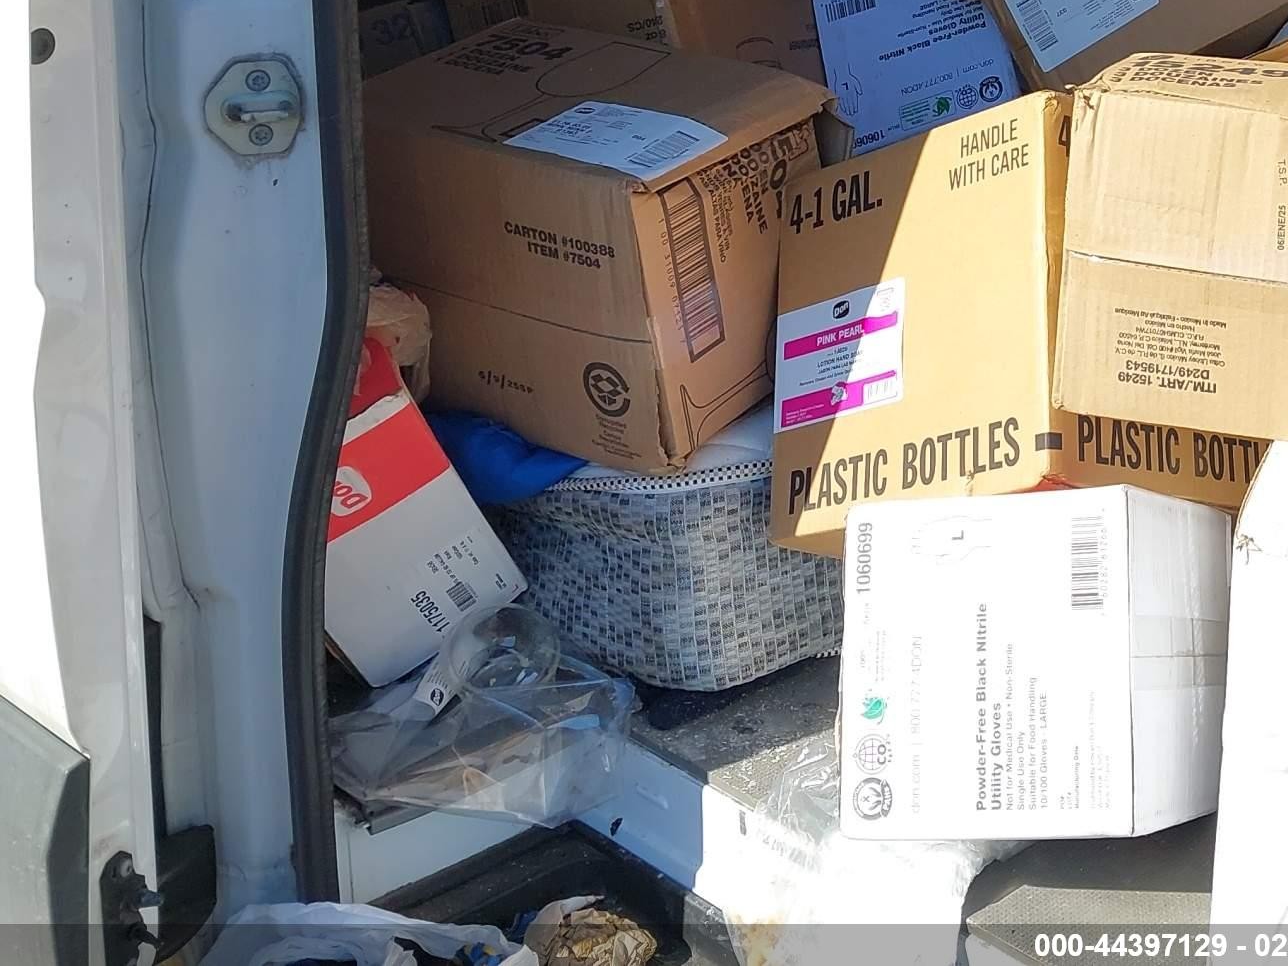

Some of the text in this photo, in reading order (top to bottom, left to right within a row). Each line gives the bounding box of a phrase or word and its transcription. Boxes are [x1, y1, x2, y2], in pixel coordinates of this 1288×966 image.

[928, 13, 985, 36] Utility Gloves
[476, 34, 574, 61] 7504
[879, 21, 986, 62] Powder-Free Black Nitrile
[963, 59, 994, 74] don.com
[1129, 77, 1237, 88] DOCENAS
[1133, 71, 1263, 85] DOUZAINES
[960, 119, 1018, 158] HANDLE
[949, 144, 1029, 191] WITH CARE
[1278, 159, 1288, 186] T.S.P.
[790, 171, 883, 234] 4-1 GAL.
[504, 221, 557, 244] CARTON
[1276, 204, 1287, 251] 06/ENE/25
[527, 242, 601, 269] ITEM #7504
[816, 324, 865, 347] PINK PEARL
[1118, 371, 1216, 393] ITM./ART. 15249
[1126, 359, 1210, 380] D249/1719543
[1077, 414, 1181, 476] PLASTIC
[788, 417, 1020, 516] PLASTIC BOTTLES
[334, 481, 369, 509] Do
[952, 530, 964, 541] L
[856, 522, 873, 594] 1060699
[410, 589, 450, 633] 1175035
[976, 658, 987, 702] Black
[1006, 710, 1014, 730] Use
[1040, 692, 1048, 728] LARGE
[1006, 732, 1014, 773] Medical
[1029, 724, 1037, 749] Food
[976, 707, 987, 811] Powder-Free
[991, 702, 1004, 810] Utility Gloves
[1017, 731, 1027, 810] Single Use Only
[1006, 793, 1014, 811] Not
[1029, 769, 1037, 810] Suitable
